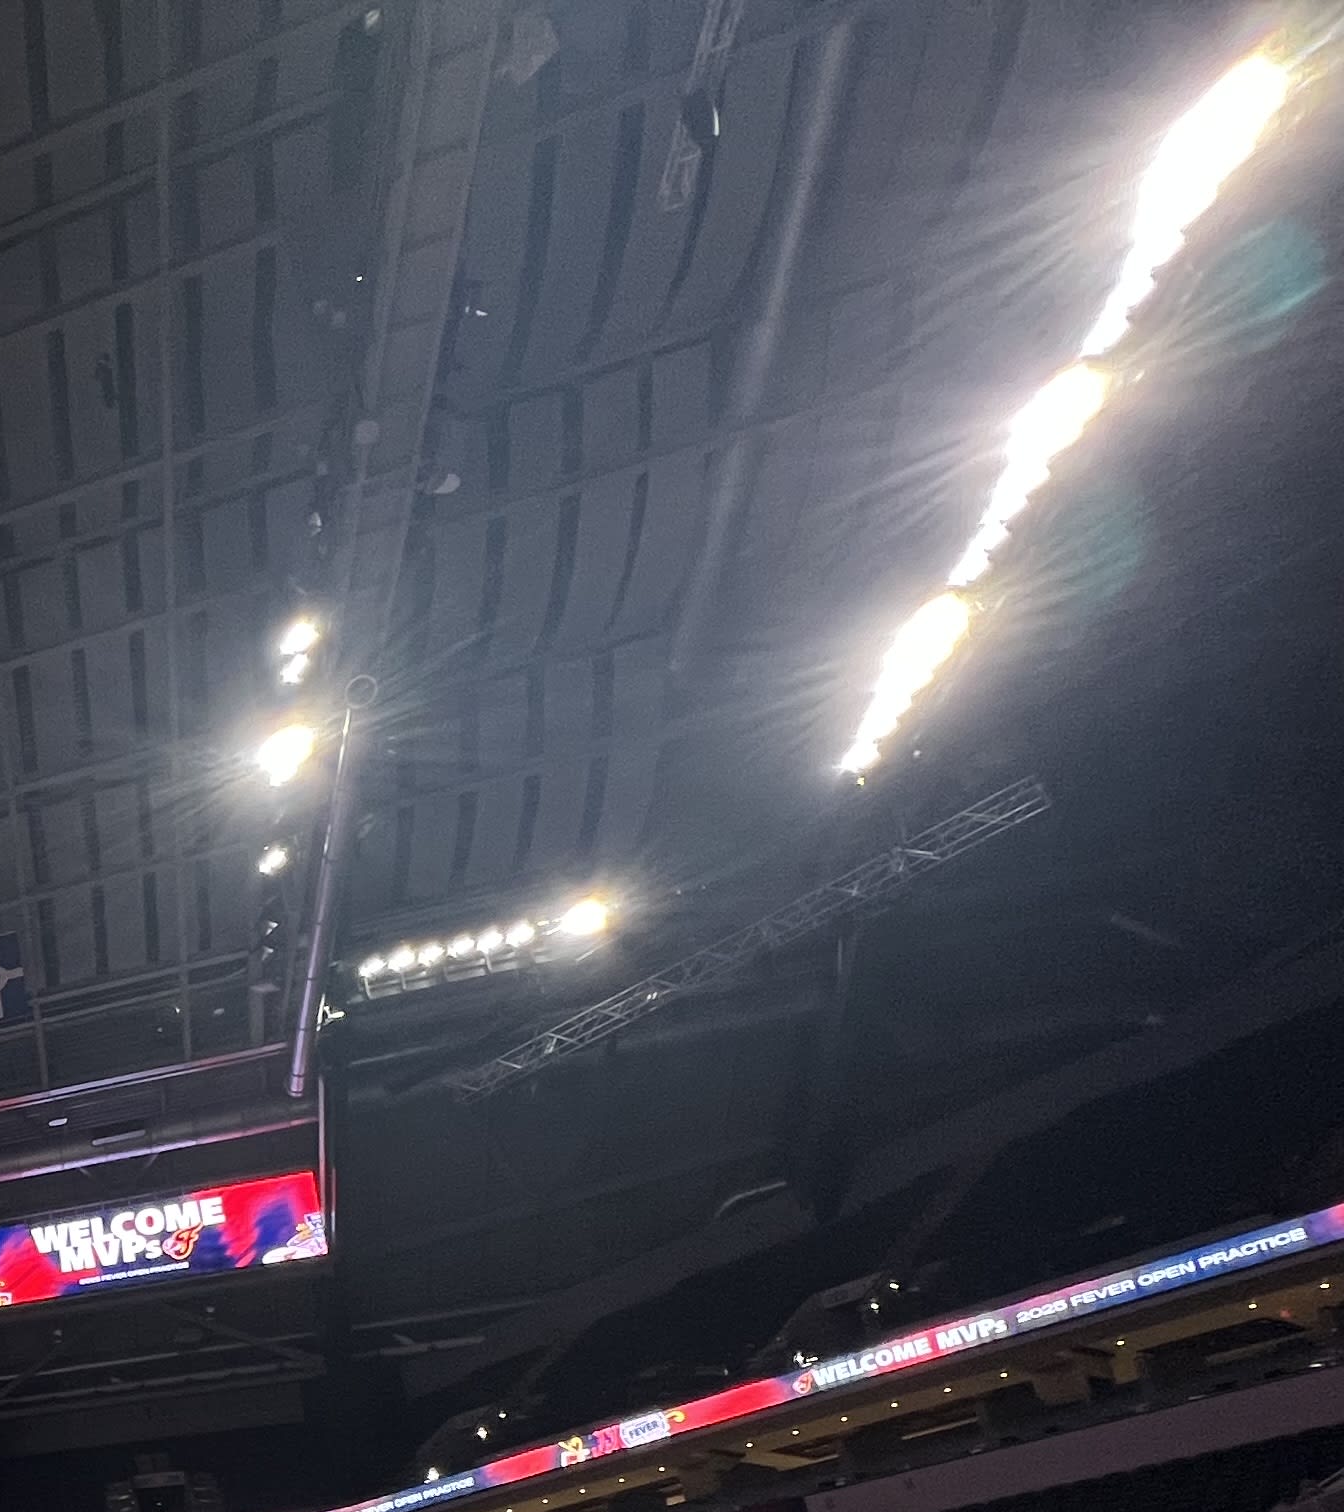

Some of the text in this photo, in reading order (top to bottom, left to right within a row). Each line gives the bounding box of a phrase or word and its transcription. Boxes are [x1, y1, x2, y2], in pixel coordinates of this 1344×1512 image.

[30, 1196, 226, 1255] WELCOME
[61, 1232, 163, 1274] MVPs
[813, 1227, 1307, 1388] WELCOME MVPs 2025 FEVER OPEN PRACTICE
[629, 1420, 660, 1440] FEVER
